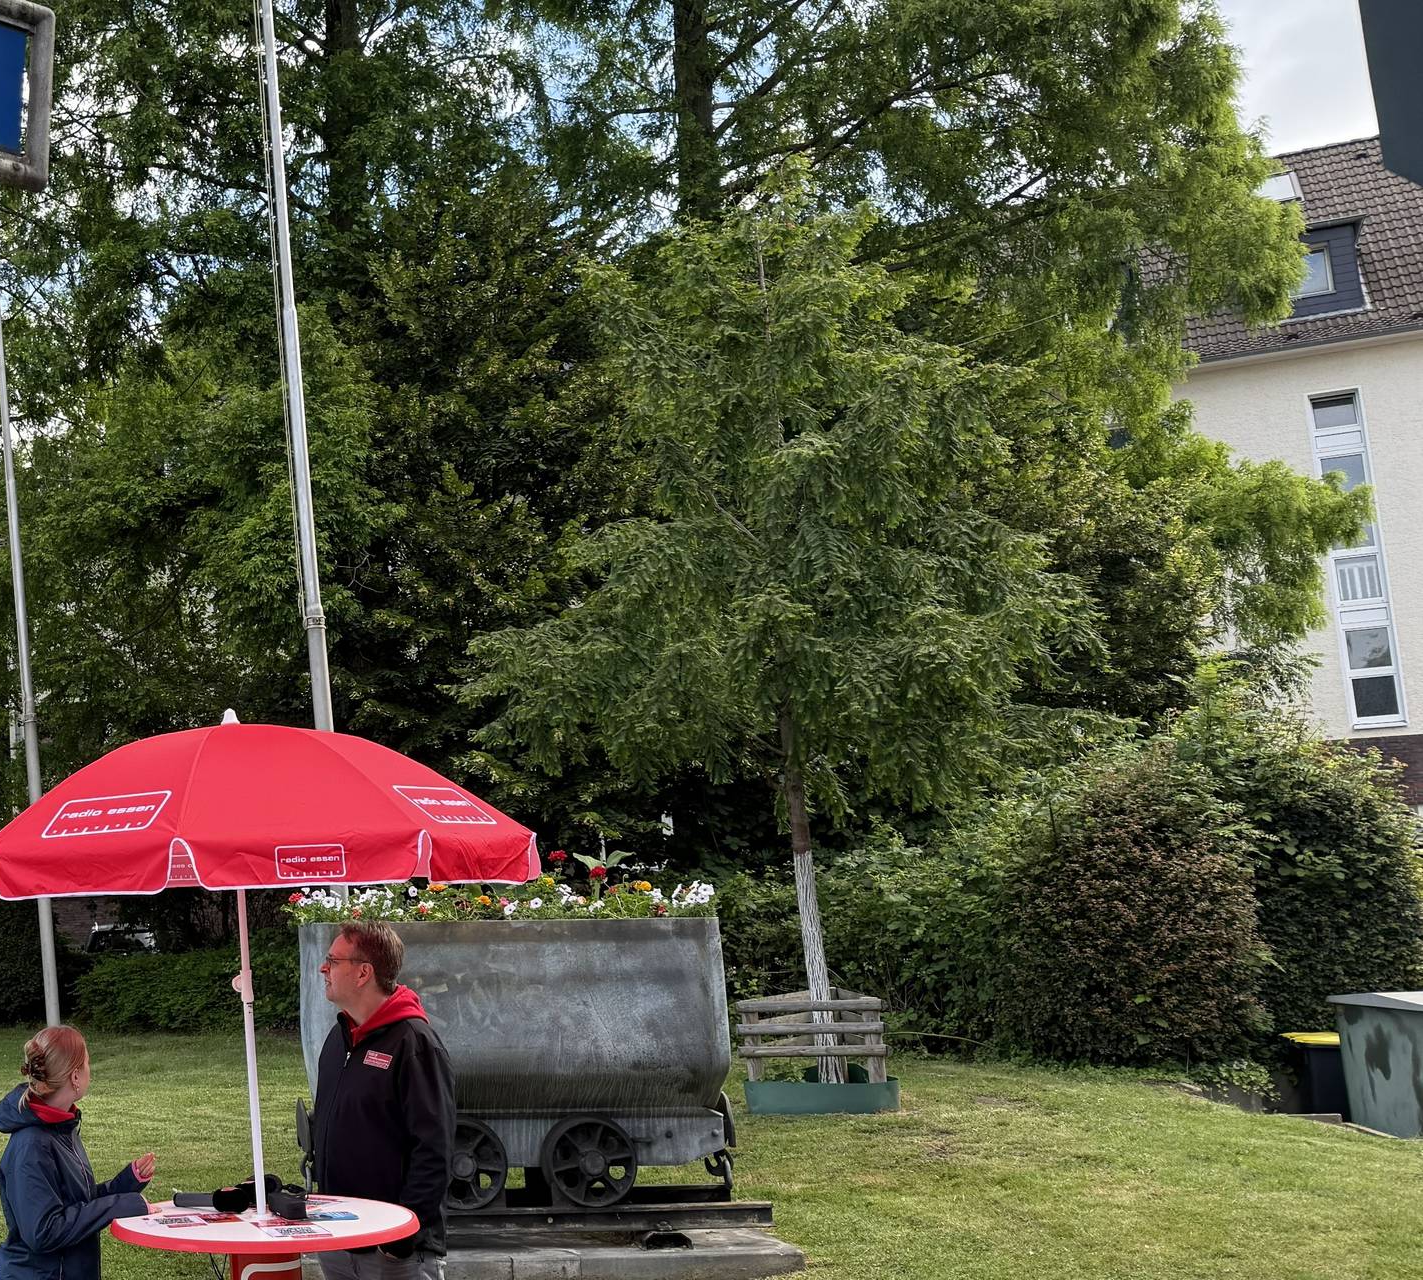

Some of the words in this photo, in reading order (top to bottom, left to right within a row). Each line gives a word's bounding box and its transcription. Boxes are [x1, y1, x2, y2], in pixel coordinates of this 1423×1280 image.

[60, 808, 103, 819] radio
[107, 804, 156, 815] essen
[280, 855, 307, 864] radio
[310, 855, 340, 863] essen
